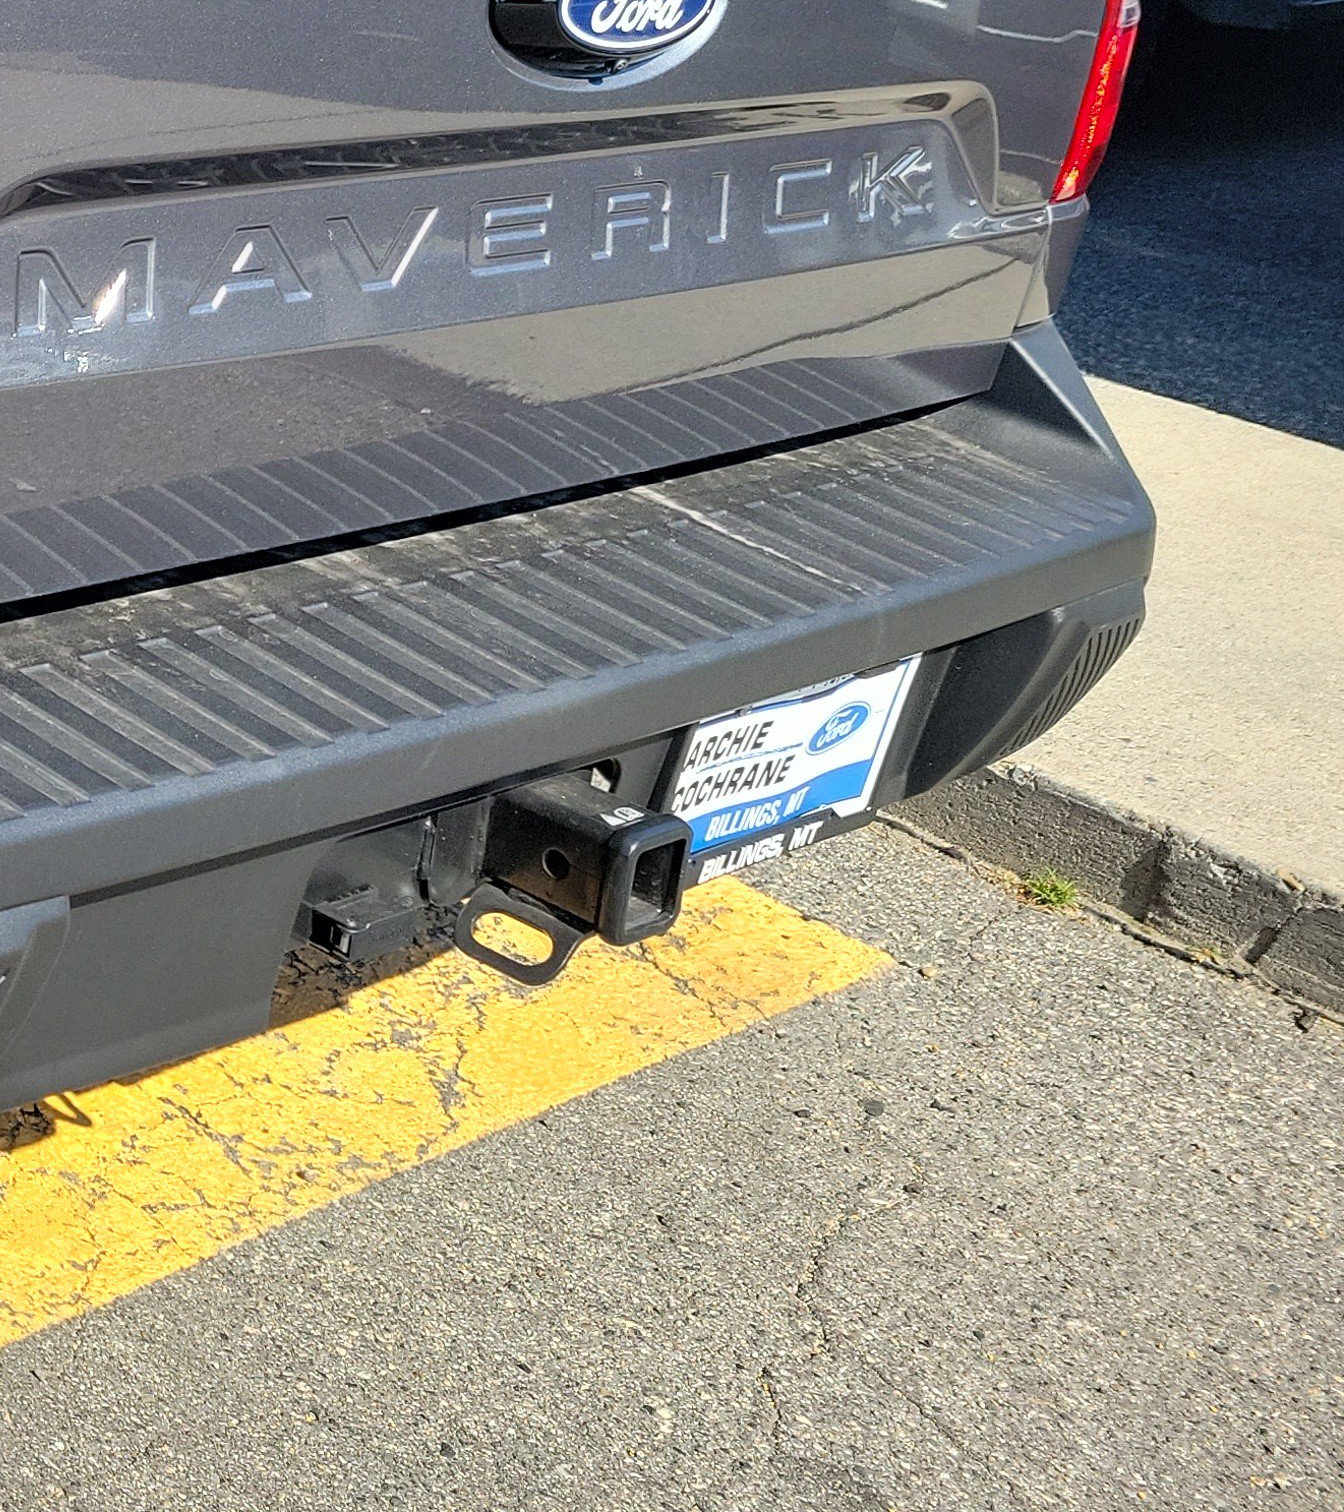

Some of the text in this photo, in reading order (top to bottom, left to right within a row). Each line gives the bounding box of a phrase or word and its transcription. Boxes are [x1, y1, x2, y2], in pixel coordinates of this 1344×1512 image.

[11, 144, 933, 338] MAVERICK
[684, 720, 775, 772] ARCHIE
[816, 709, 860, 748] Ford
[671, 753, 797, 813] COCHRANE
[704, 785, 811, 842] BILLINGS, MT
[697, 819, 825, 885] BILLINGS, MT
